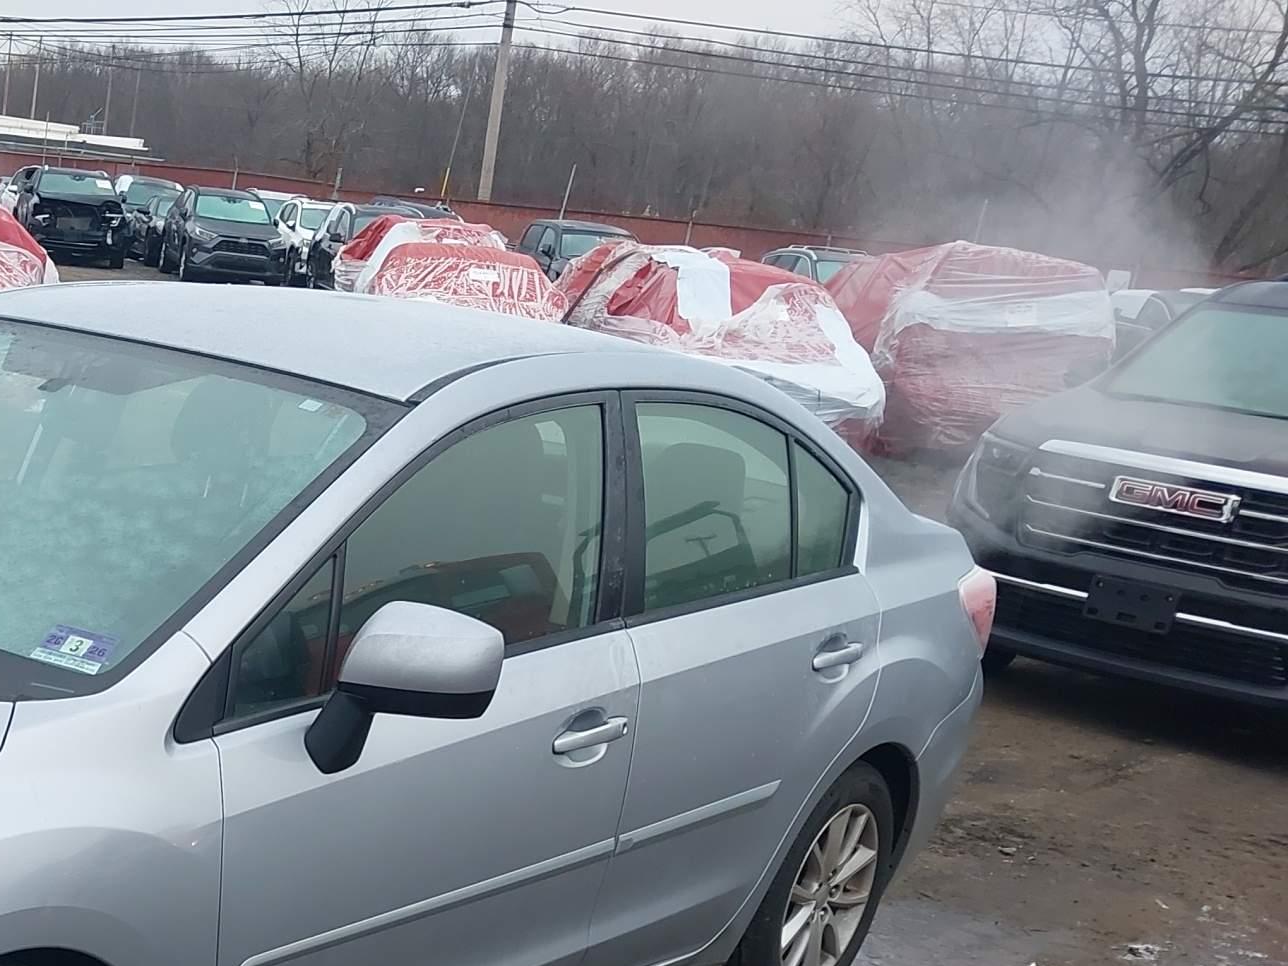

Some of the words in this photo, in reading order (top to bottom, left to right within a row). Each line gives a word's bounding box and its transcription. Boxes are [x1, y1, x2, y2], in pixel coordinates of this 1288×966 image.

[1118, 480, 1226, 519] GMC
[69, 639, 84, 653] 3
[88, 646, 108, 658] 26
